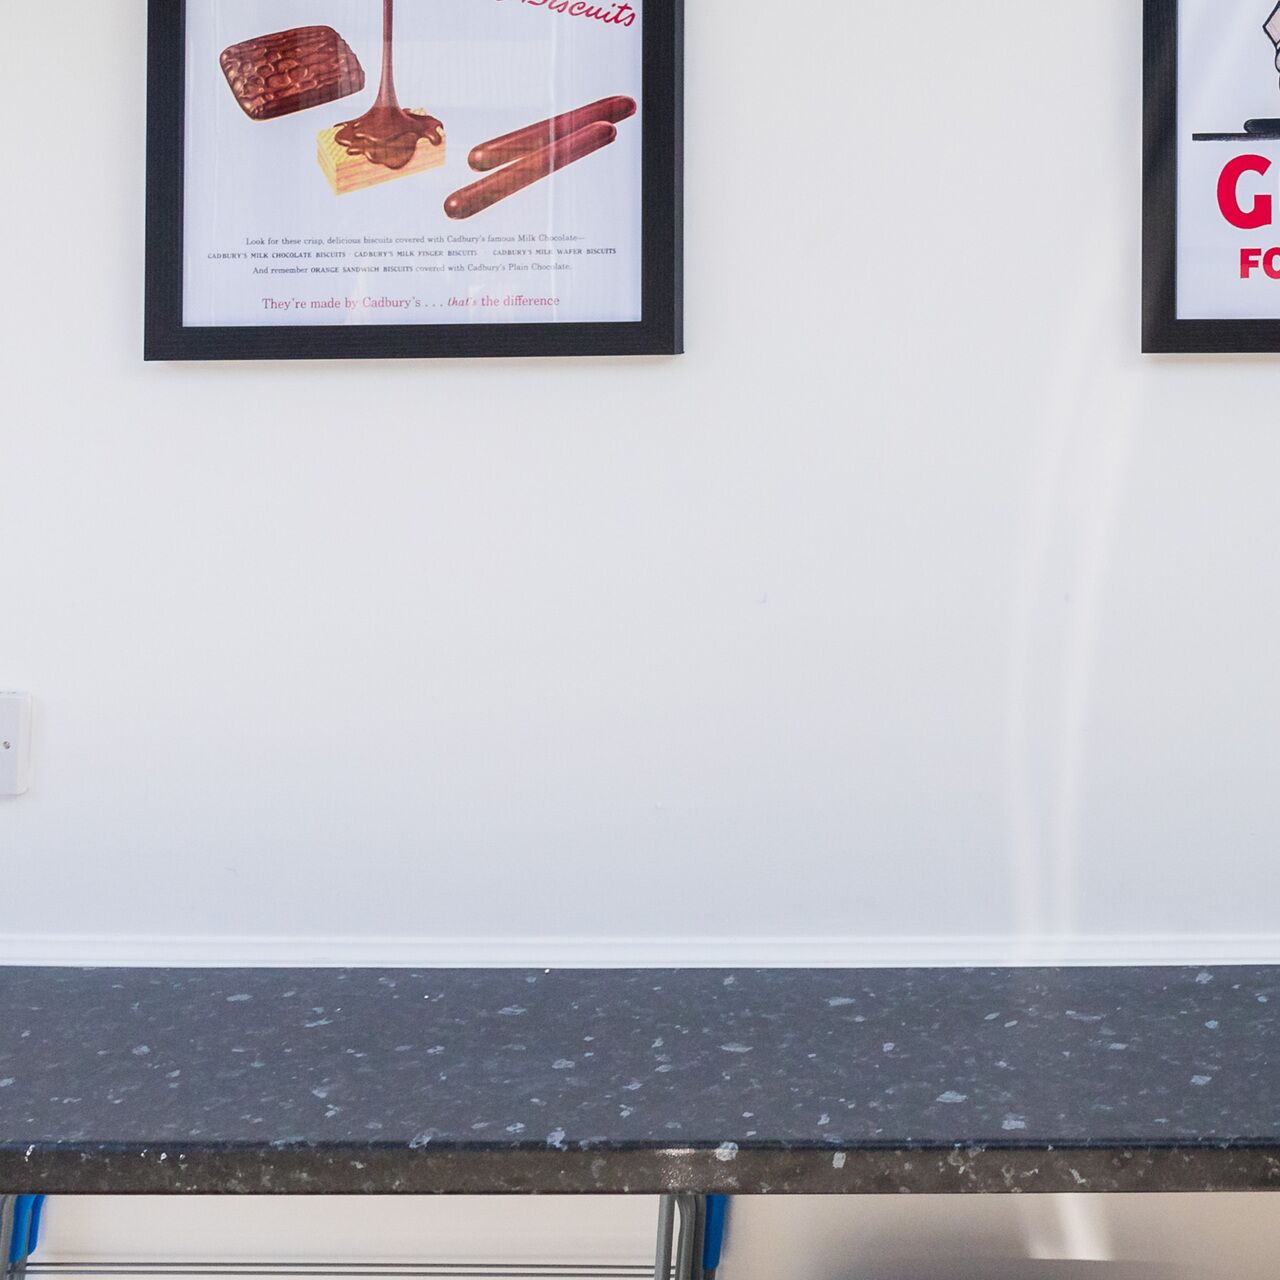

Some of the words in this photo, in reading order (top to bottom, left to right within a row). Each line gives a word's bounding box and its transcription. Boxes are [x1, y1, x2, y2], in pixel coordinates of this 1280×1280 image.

[262, 297, 306, 310] They're
[310, 297, 340, 309] made
[344, 297, 358, 310] by
[481, 295, 500, 307] the
[503, 295, 560, 307] difference
